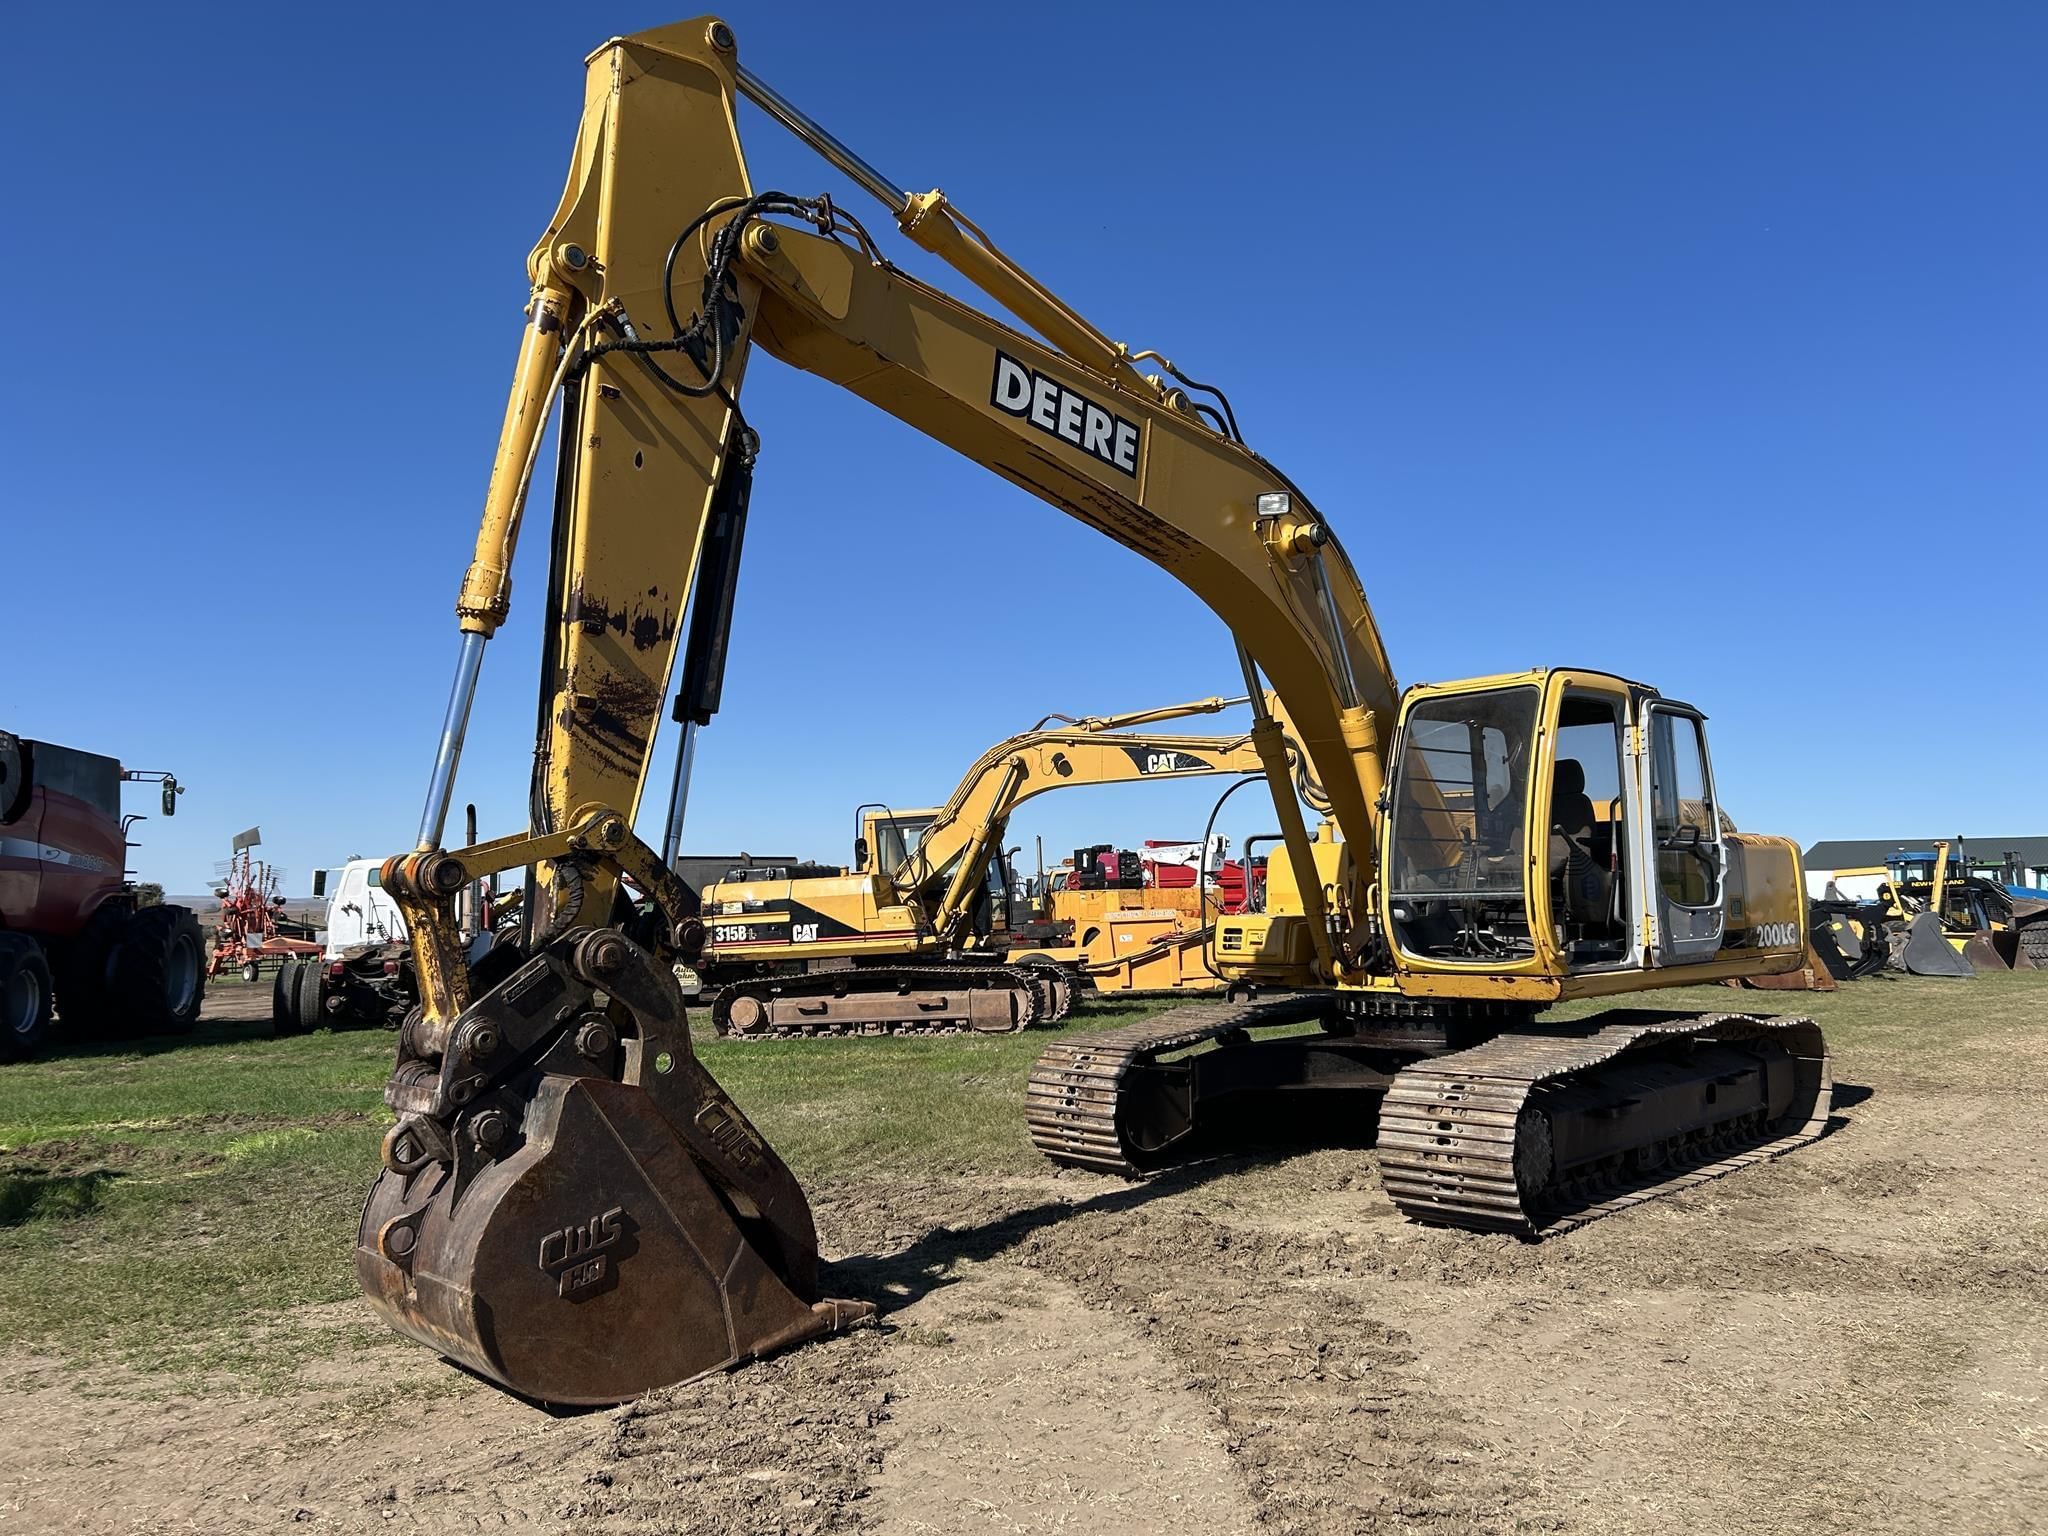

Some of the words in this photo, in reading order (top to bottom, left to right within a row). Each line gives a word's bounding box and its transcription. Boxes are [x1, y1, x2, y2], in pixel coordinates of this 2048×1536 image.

[995, 356, 1138, 473] DEERE
[1147, 753, 1178, 773] CAT
[715, 925, 747, 942] 315B
[793, 924, 819, 942] CAT
[1756, 922, 1796, 947] 200LC
[694, 1102, 762, 1164] CWS
[539, 1206, 624, 1270] CWS
